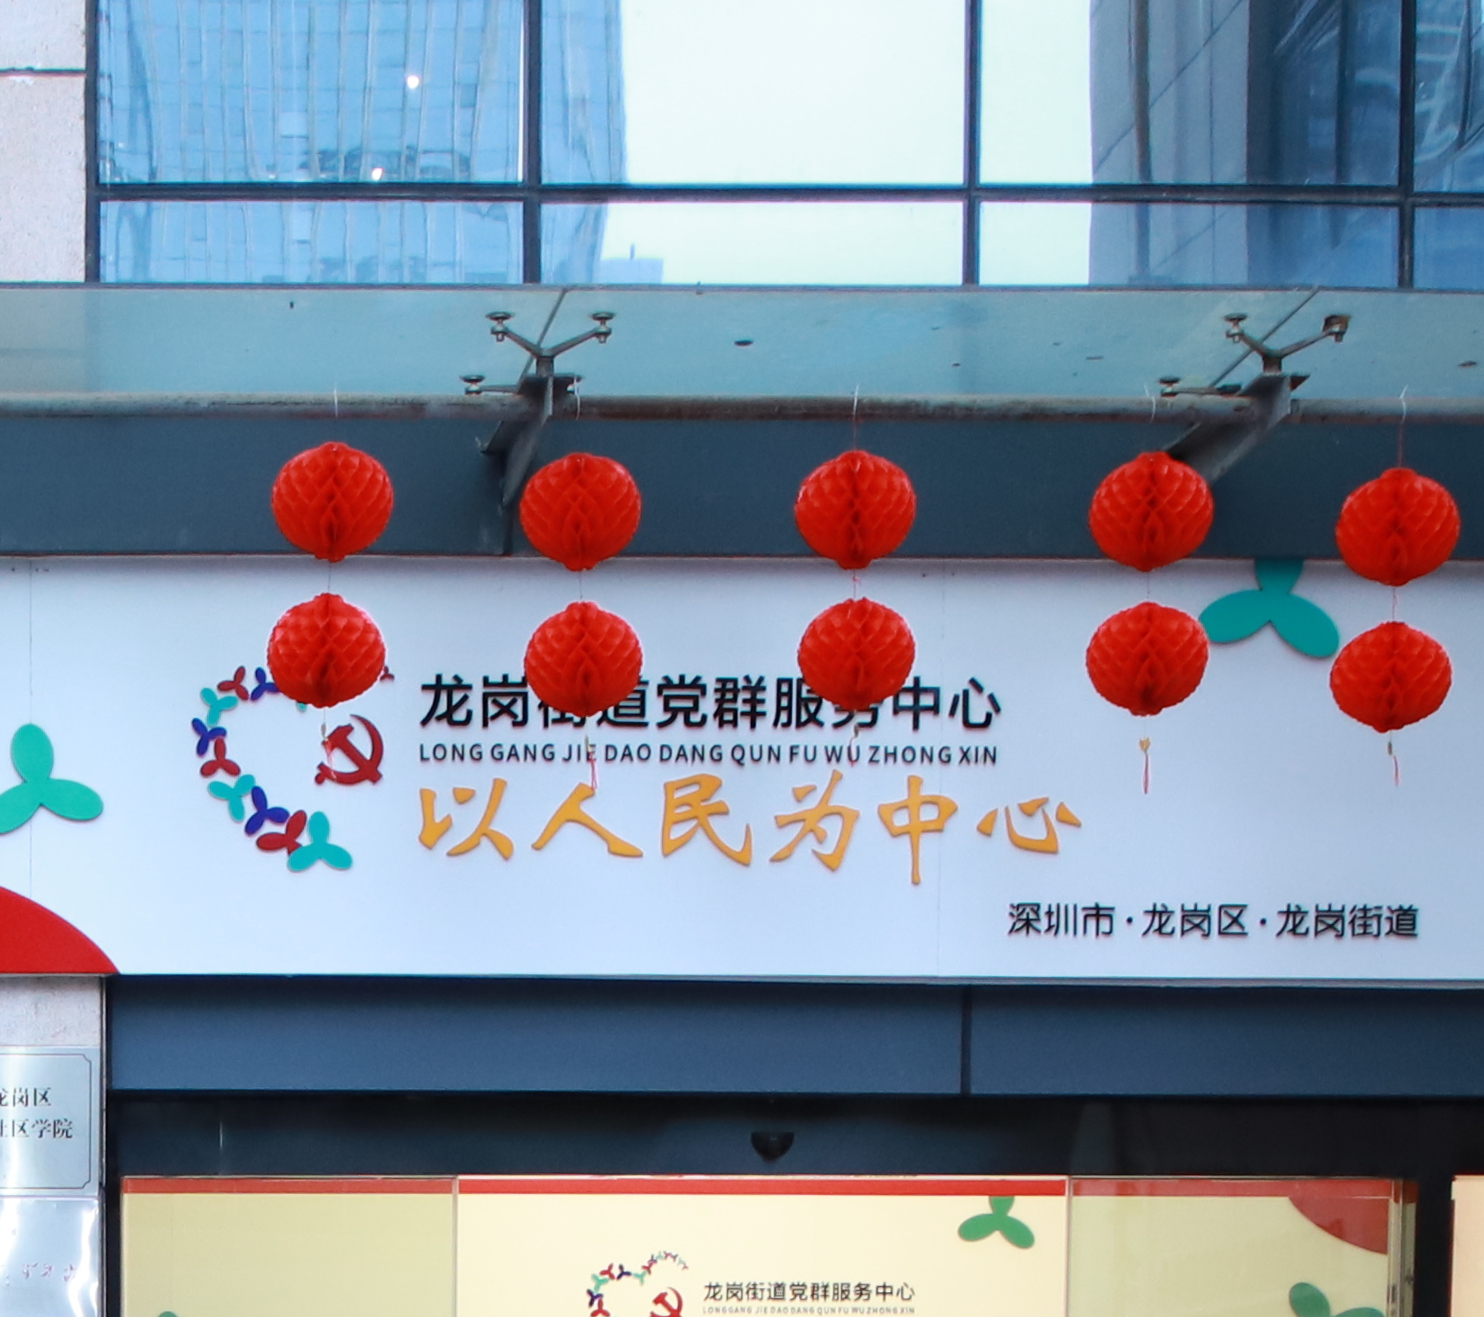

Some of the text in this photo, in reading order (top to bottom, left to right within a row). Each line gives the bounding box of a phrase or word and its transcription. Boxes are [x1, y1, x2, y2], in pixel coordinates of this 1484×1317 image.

[419, 742, 998, 767] LONG GANG JIE DAO DANG QUN FU WU ZHONG XIN
[419, 770, 1083, 886] 以人民为中心
[703, 1281, 916, 1302] 龙岗街道党群服务中心
